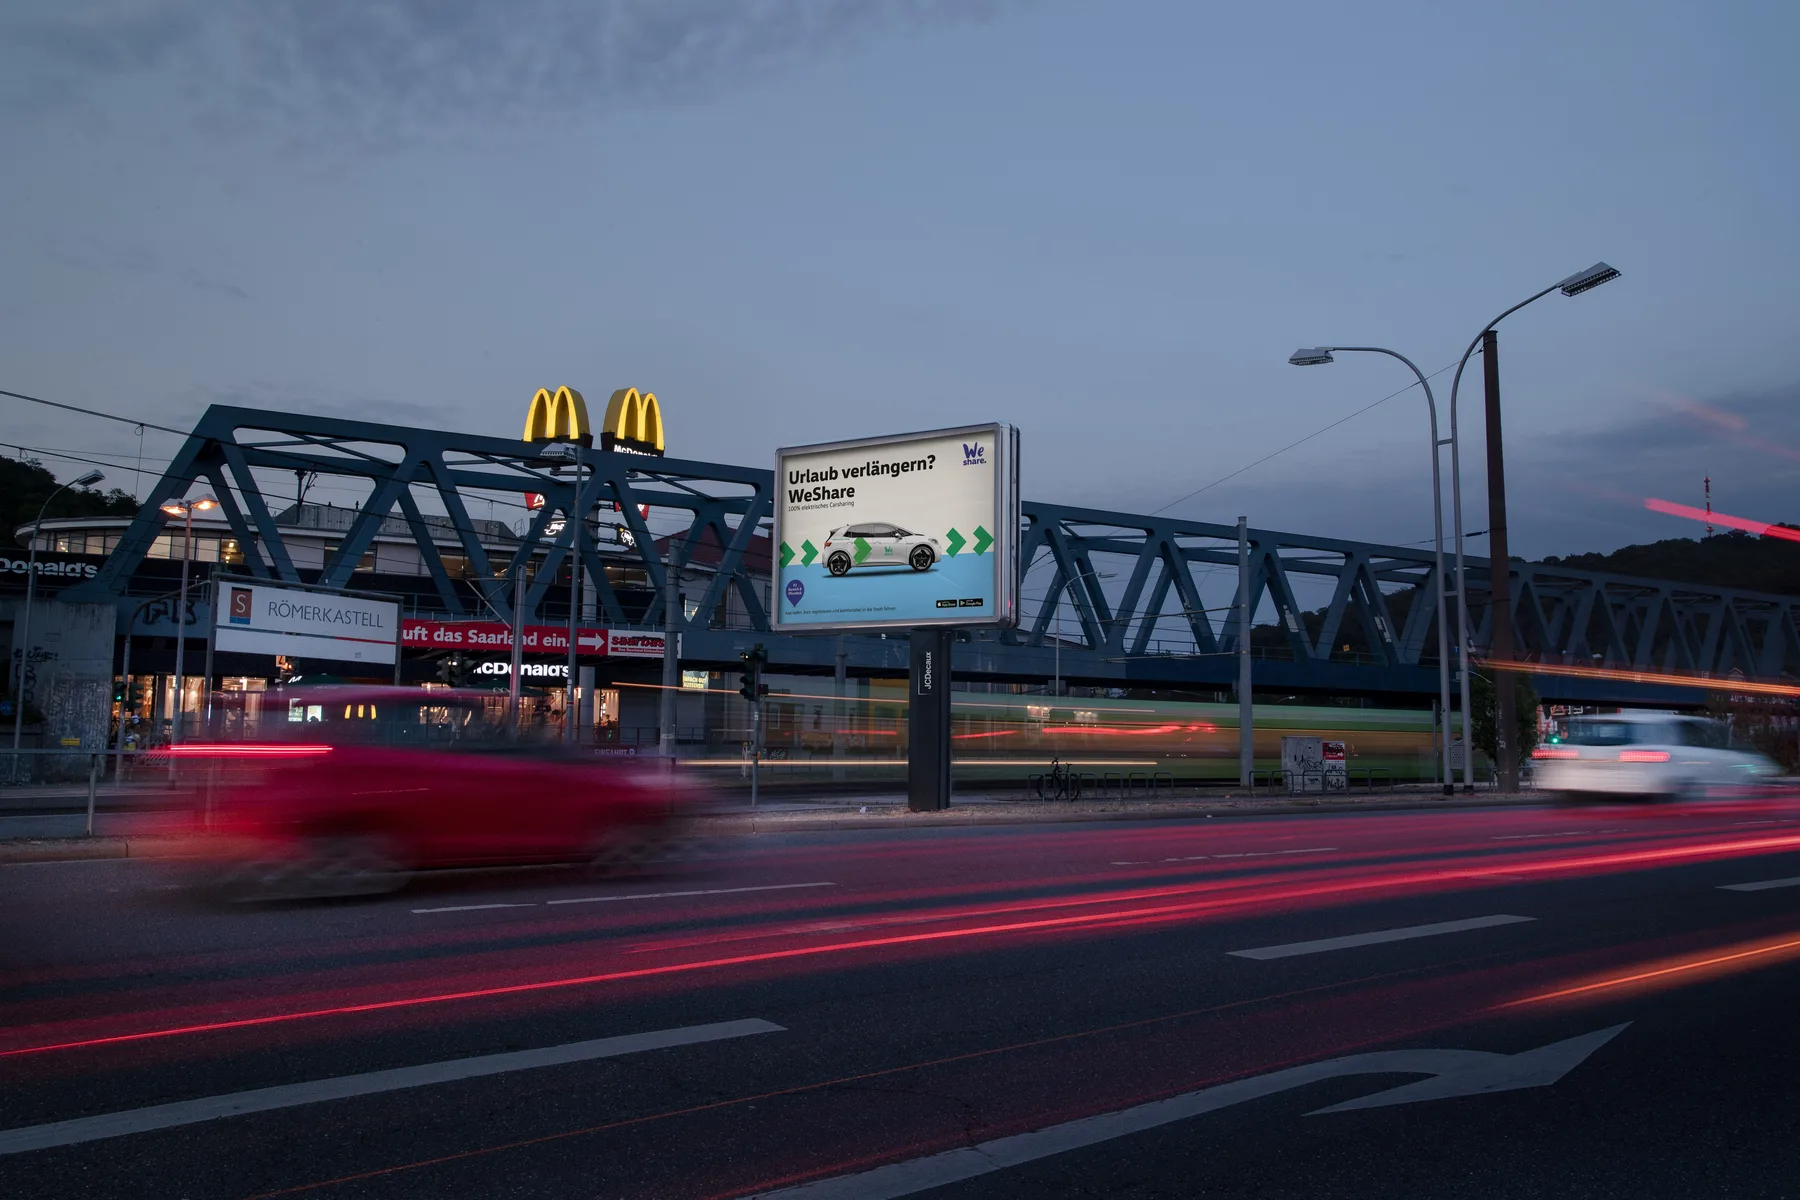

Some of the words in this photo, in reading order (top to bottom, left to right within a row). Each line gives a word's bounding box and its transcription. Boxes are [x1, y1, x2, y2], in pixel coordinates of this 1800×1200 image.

[963, 442, 984, 458] We
[789, 466, 839, 485] Urlaub
[842, 454, 936, 477] verlängern?
[788, 486, 855, 503] WeShare
[236, 594, 246, 613] S
[268, 600, 383, 628] RÖMERKASTELL
[402, 626, 428, 642] uft
[433, 627, 462, 643] das
[543, 633, 570, 648] ein.
[611, 635, 665, 647] saarbas
[473, 662, 569, 678] cDnald's
